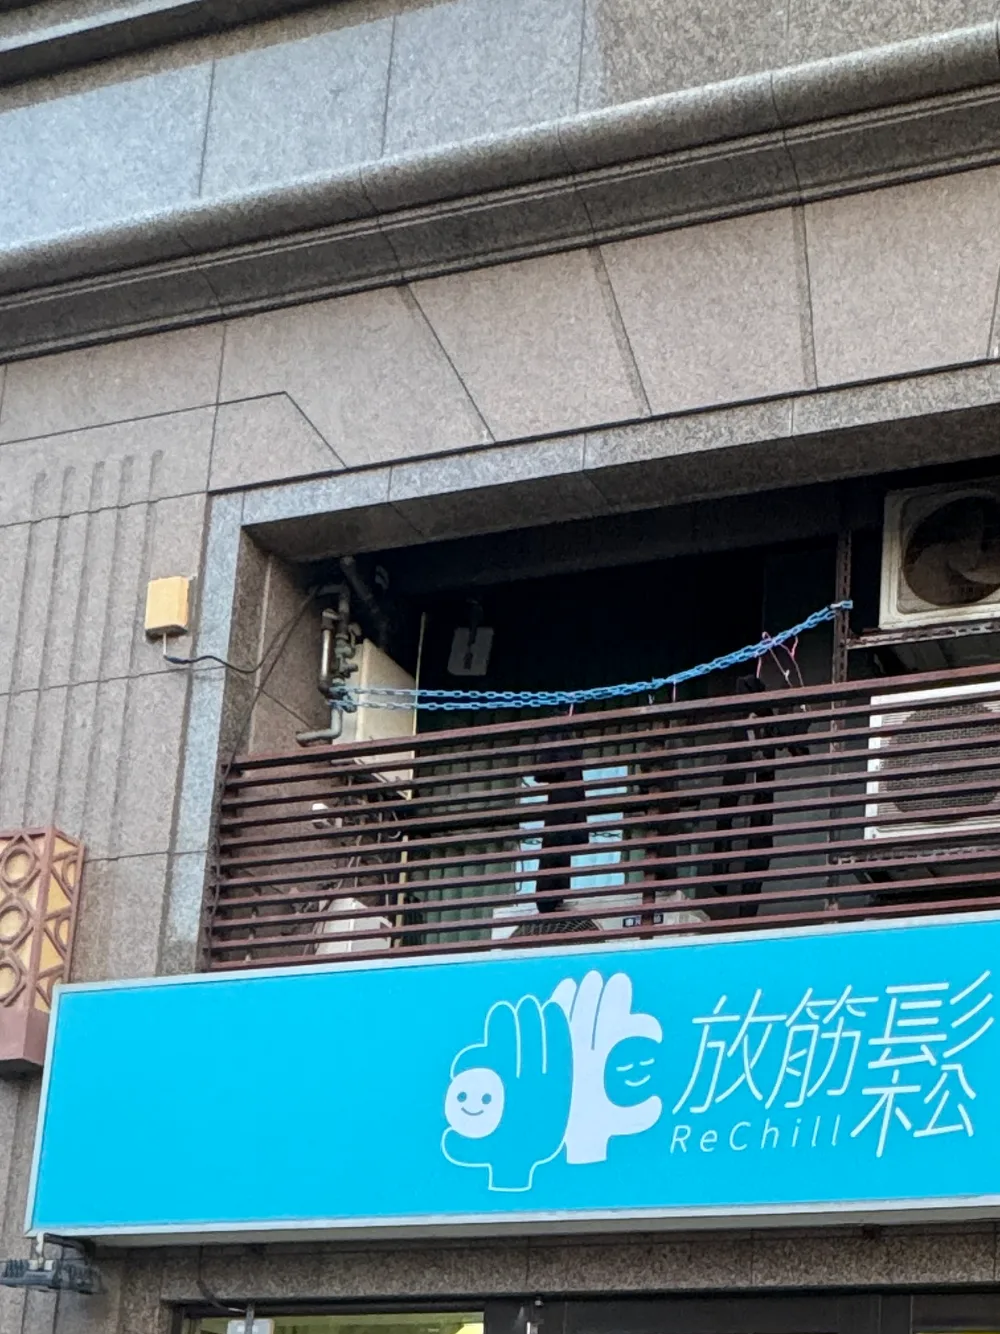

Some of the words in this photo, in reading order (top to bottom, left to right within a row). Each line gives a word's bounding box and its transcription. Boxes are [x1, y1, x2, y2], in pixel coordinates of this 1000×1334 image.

[672, 970, 994, 1158] 放筋鬆
[670, 1115, 840, 1153] ReChill
